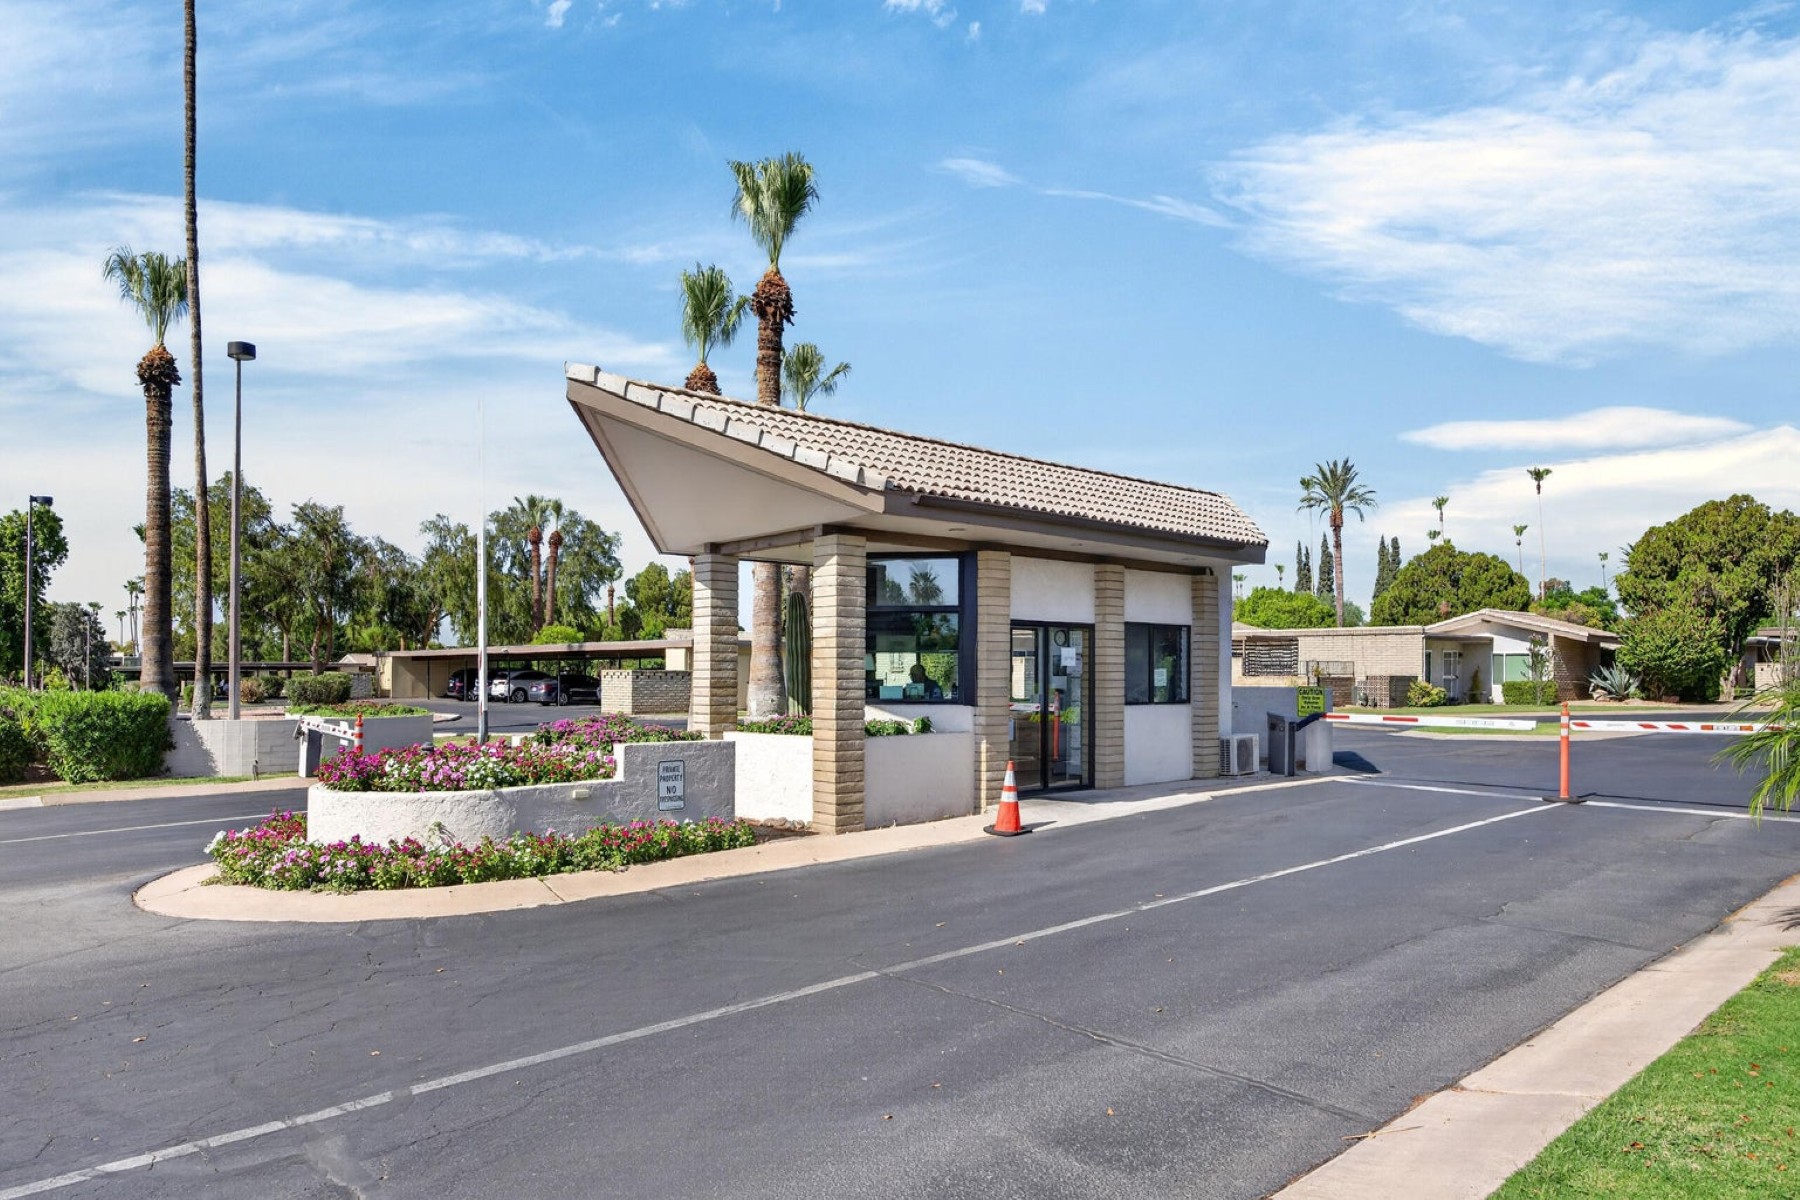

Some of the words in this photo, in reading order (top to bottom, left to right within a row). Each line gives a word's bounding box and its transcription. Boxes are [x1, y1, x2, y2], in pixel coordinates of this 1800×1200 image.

[1299, 687, 1323, 695] CAUTION
[662, 765, 681, 773] PRIVATE
[660, 774, 683, 782] PROPERTY
[666, 785, 677, 795] NO
